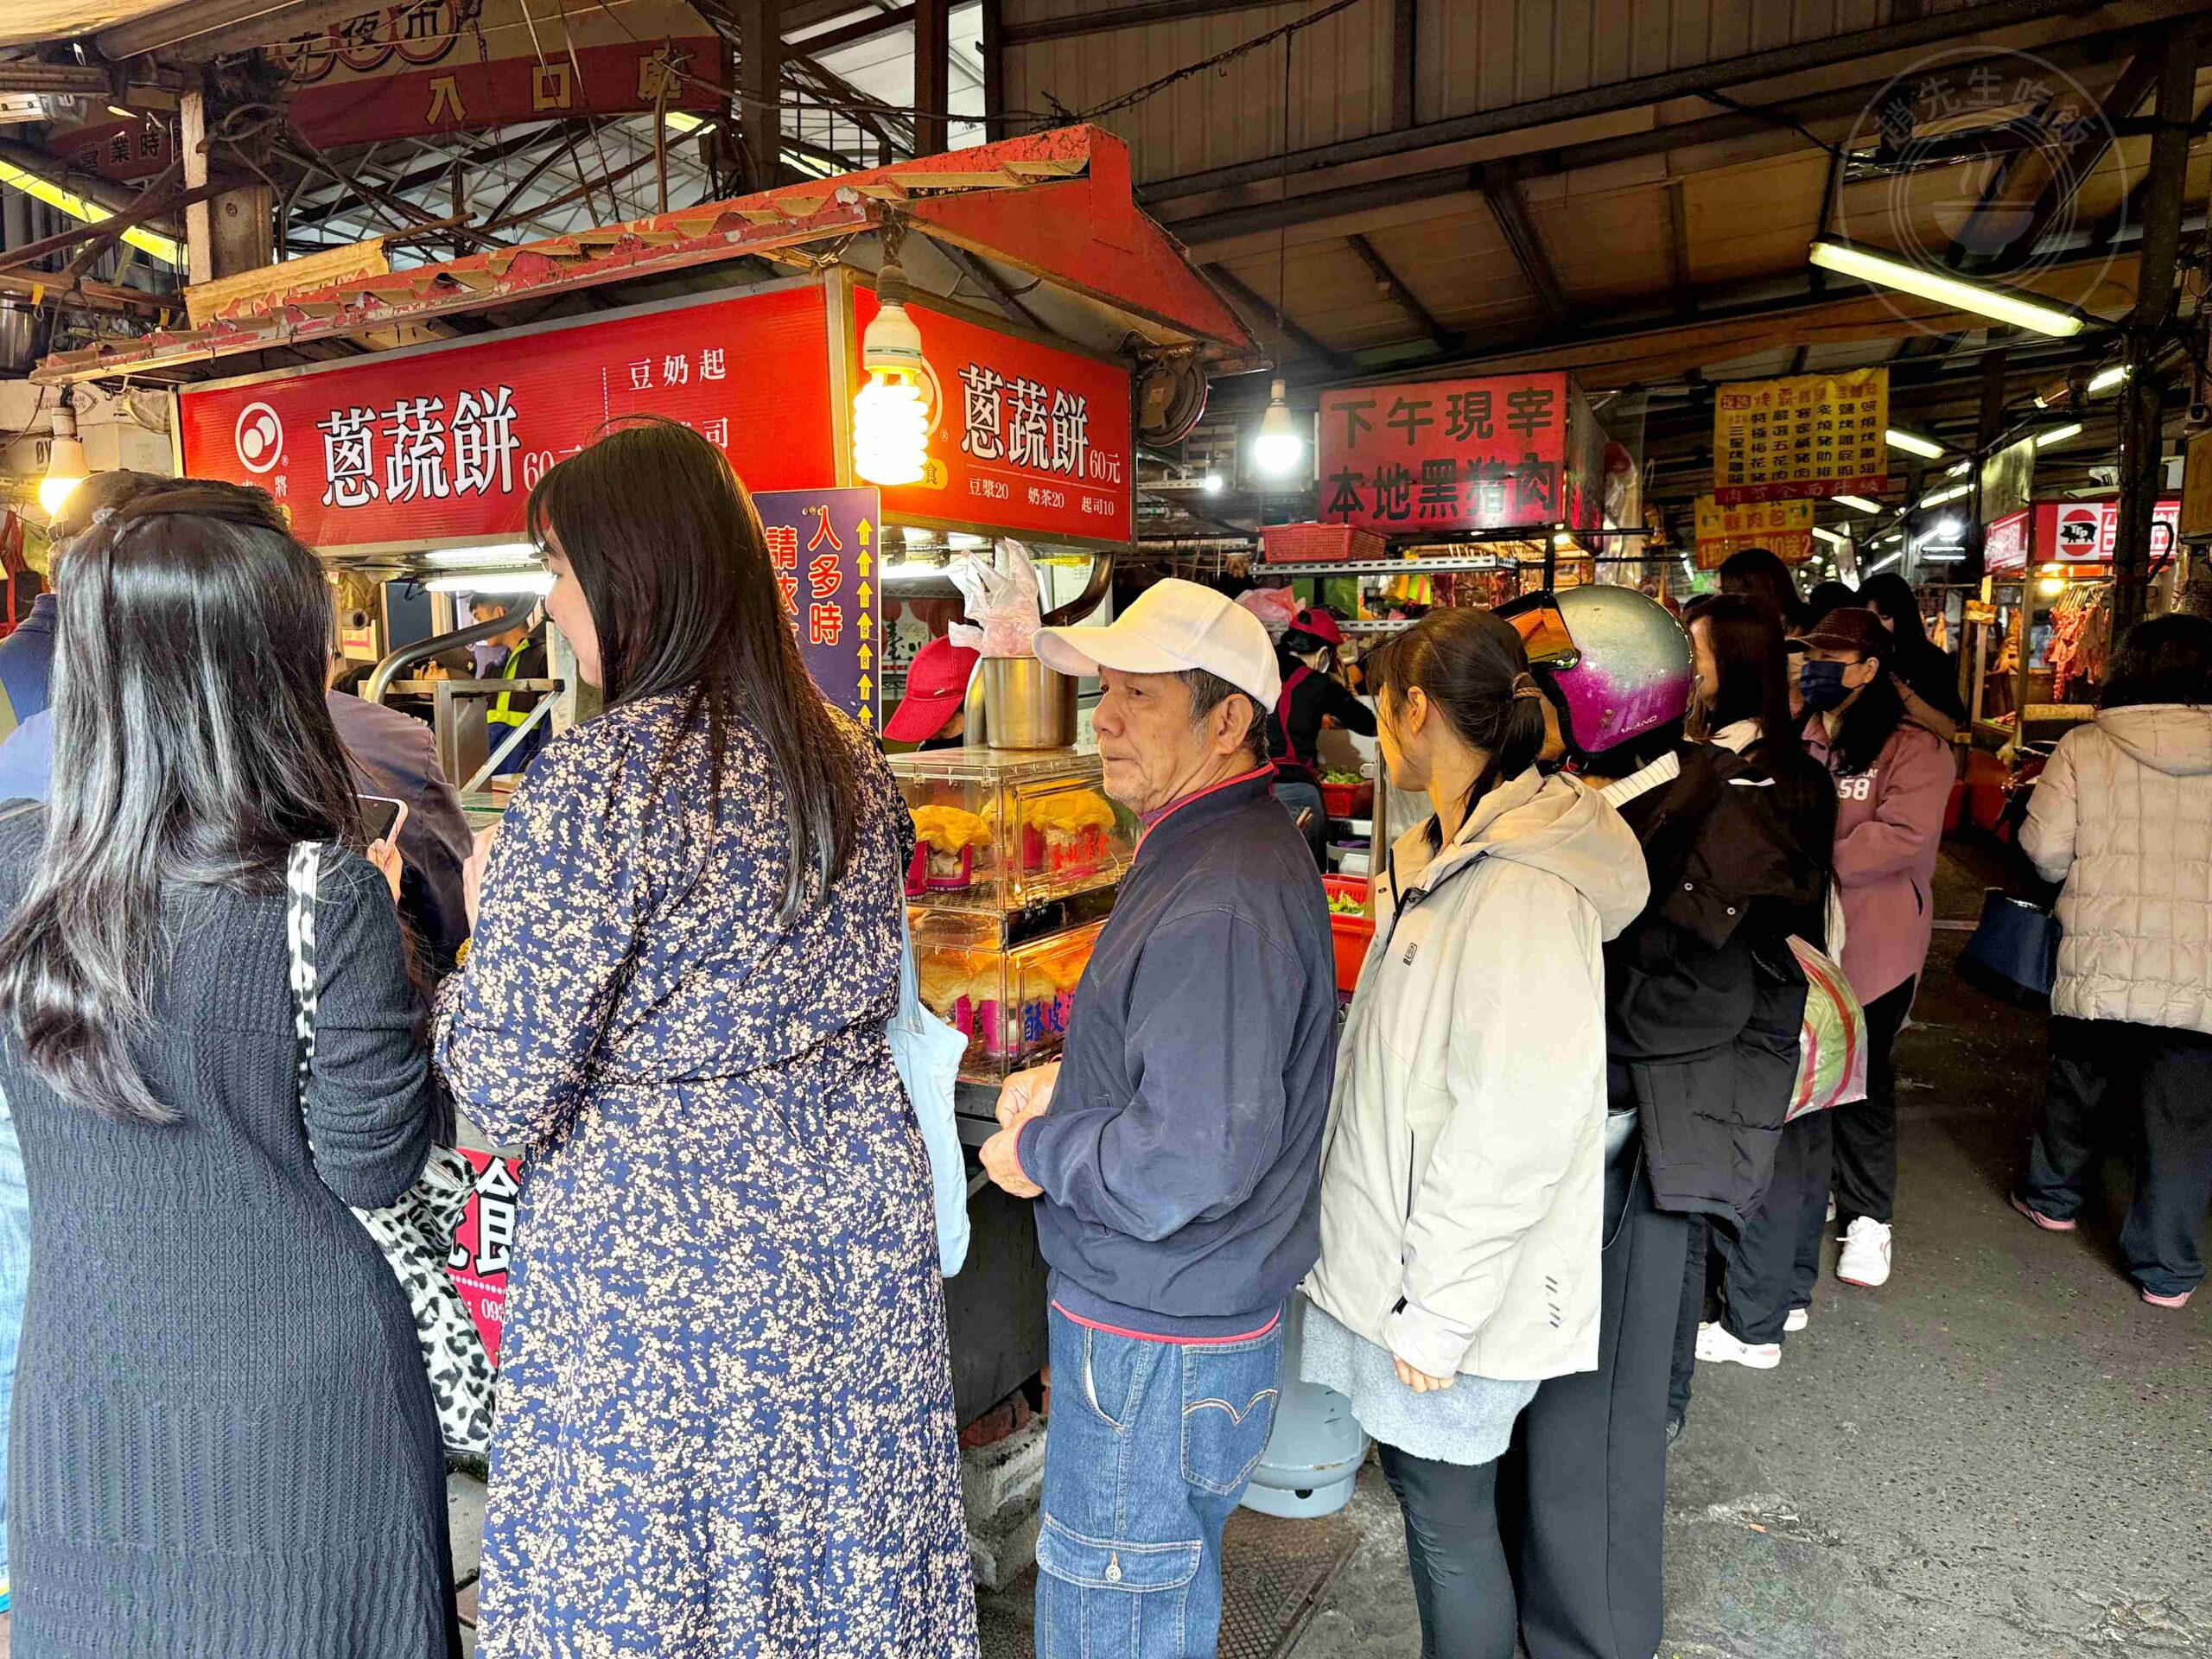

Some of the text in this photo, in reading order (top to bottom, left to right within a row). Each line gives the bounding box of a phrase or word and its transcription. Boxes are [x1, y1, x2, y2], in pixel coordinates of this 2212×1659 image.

[427, 47, 684, 124] 入口處
[316, 385, 520, 507] 蔥蔬餅
[957, 362, 1090, 480] 蔥蔬餅
[1330, 386, 1554, 448] 下午現宰
[1027, 486, 1065, 510] 奶茶20
[1080, 495, 1115, 518] 起司10
[807, 505, 842, 646] 人多時
[1837, 778, 1870, 801] 58
